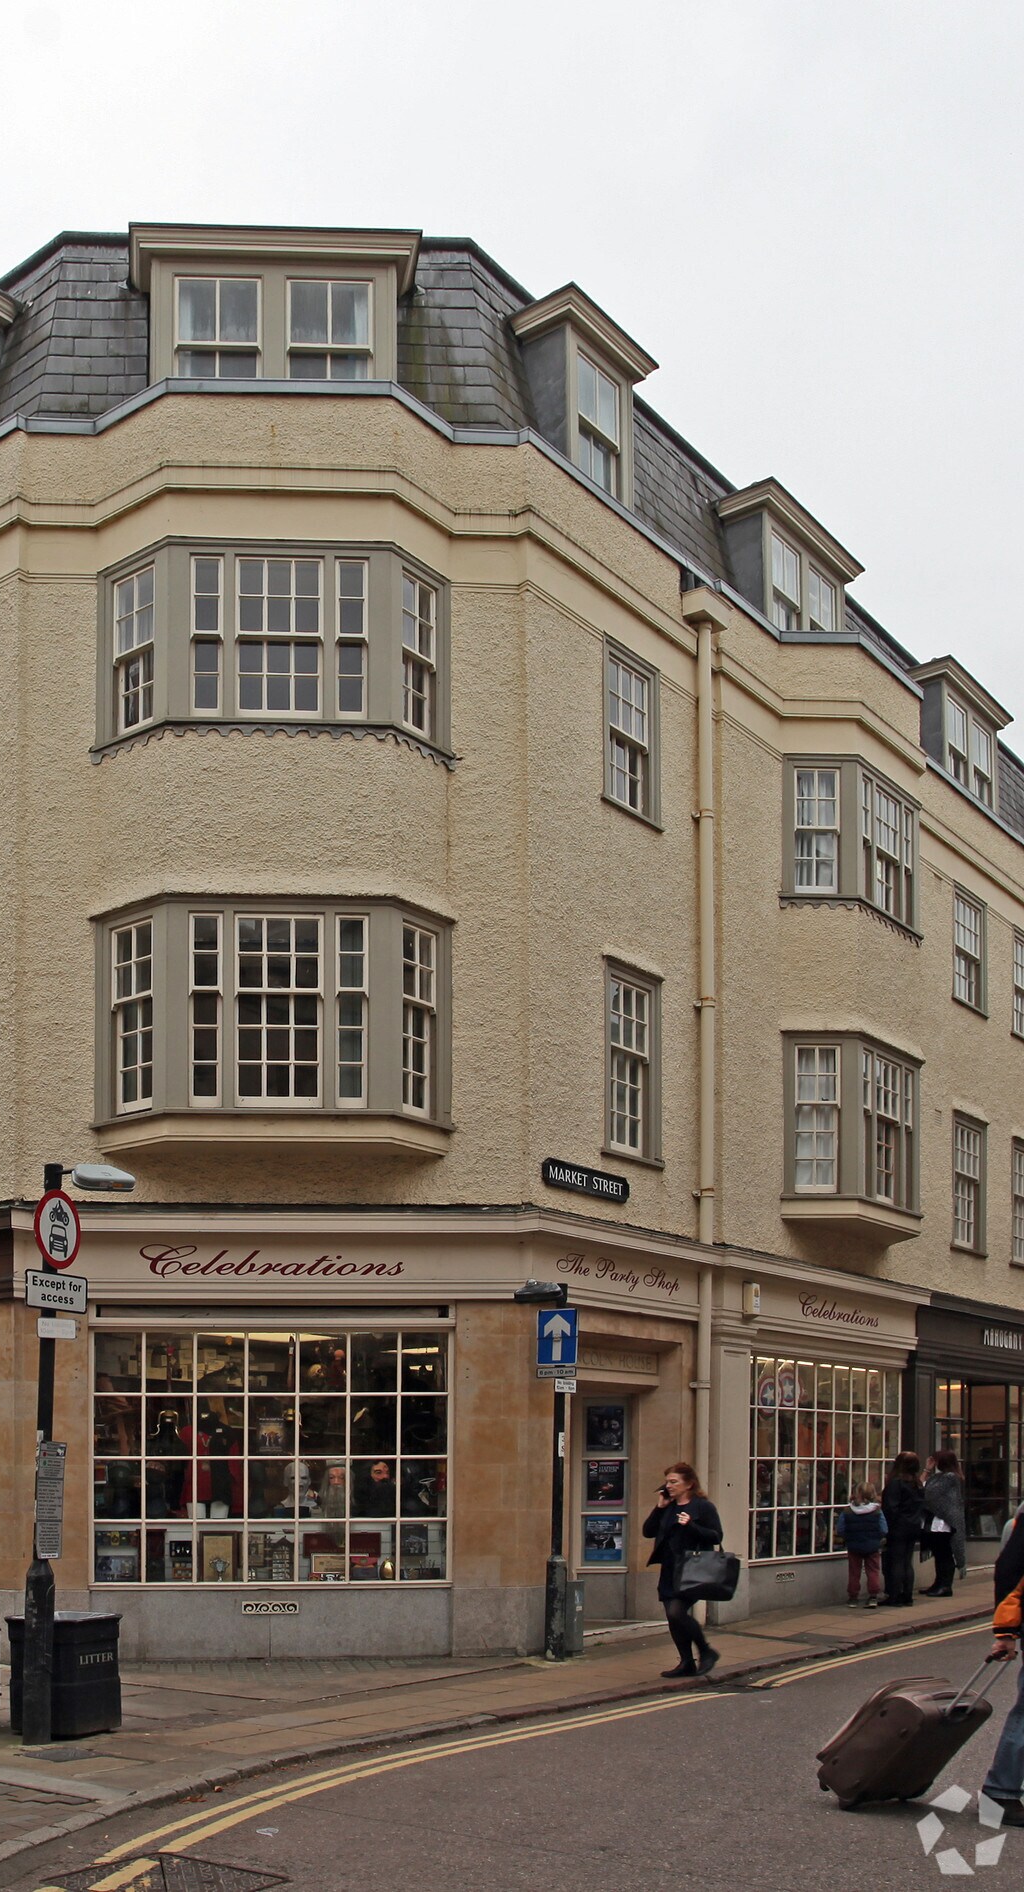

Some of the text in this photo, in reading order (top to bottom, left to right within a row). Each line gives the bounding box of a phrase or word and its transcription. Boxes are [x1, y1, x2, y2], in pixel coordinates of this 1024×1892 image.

[549, 1165, 623, 1196] MARKET STREET
[139, 1243, 405, 1278] Celebrations
[32, 1275, 83, 1293] Except for
[556, 1252, 680, 1296] The Party Shop
[41, 1293, 74, 1305] access
[798, 1291, 879, 1327] Celebrations
[983, 1328, 1023, 1351] MAHOGANY
[619, 1352, 653, 1371] HOUSE
[79, 1652, 114, 1666] LITTER
